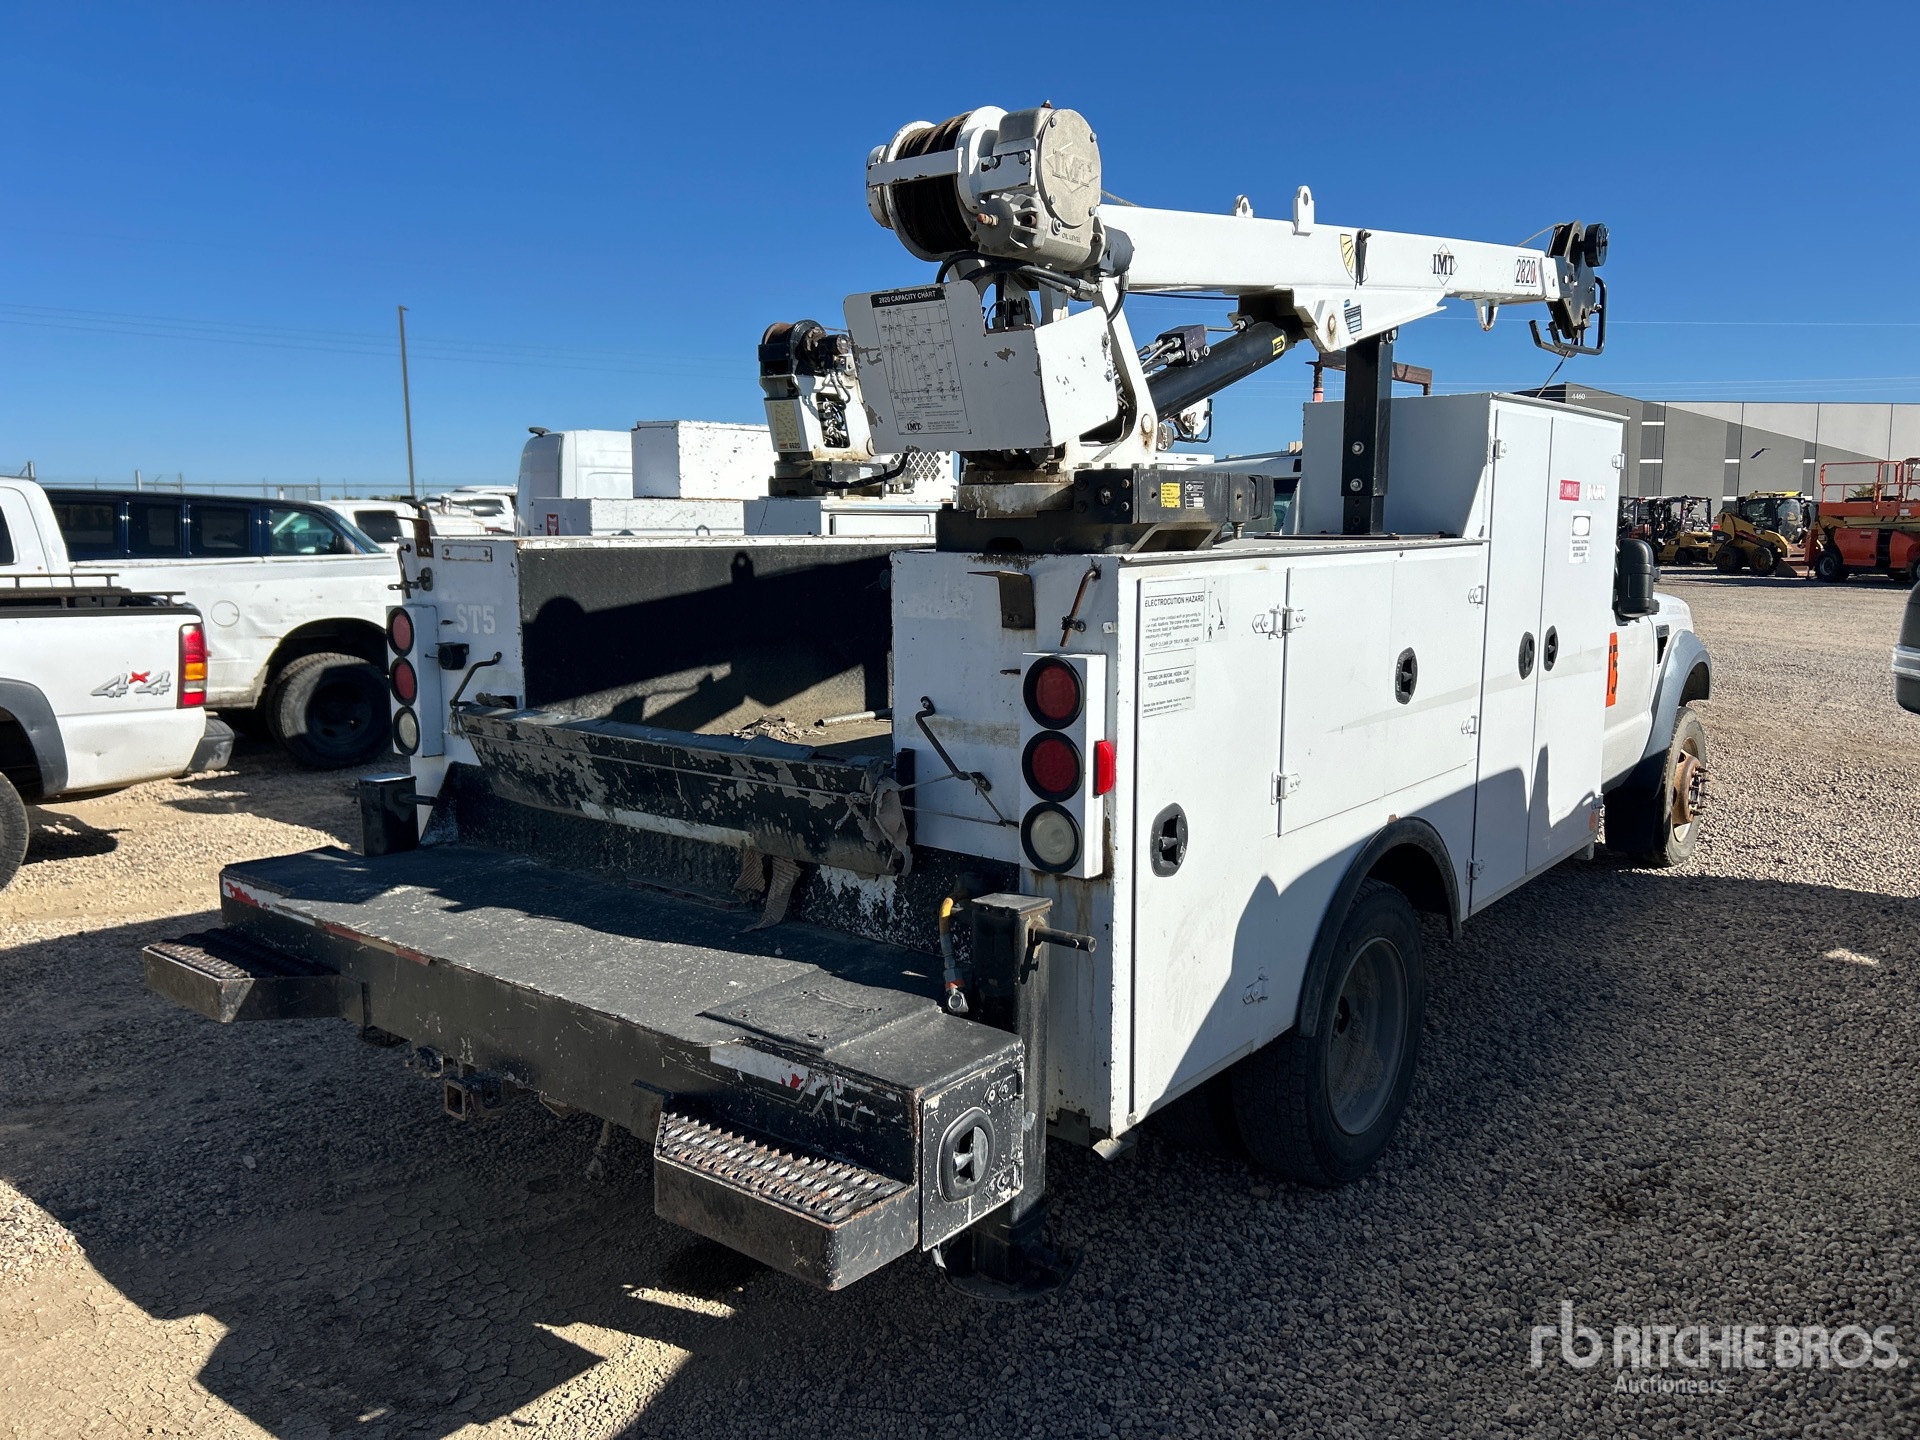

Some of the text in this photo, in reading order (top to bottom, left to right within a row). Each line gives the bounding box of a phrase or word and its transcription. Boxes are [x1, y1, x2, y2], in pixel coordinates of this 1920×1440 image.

[1433, 254, 1454, 275] IMT
[1515, 259, 1536, 284] 2820
[890, 293, 917, 303] CAPACITY
[917, 290, 936, 299] CHART
[907, 422, 921, 430] IMT
[1144, 594, 1204, 608] ELECTROCUTION HAZARD
[456, 603, 496, 635] ST5
